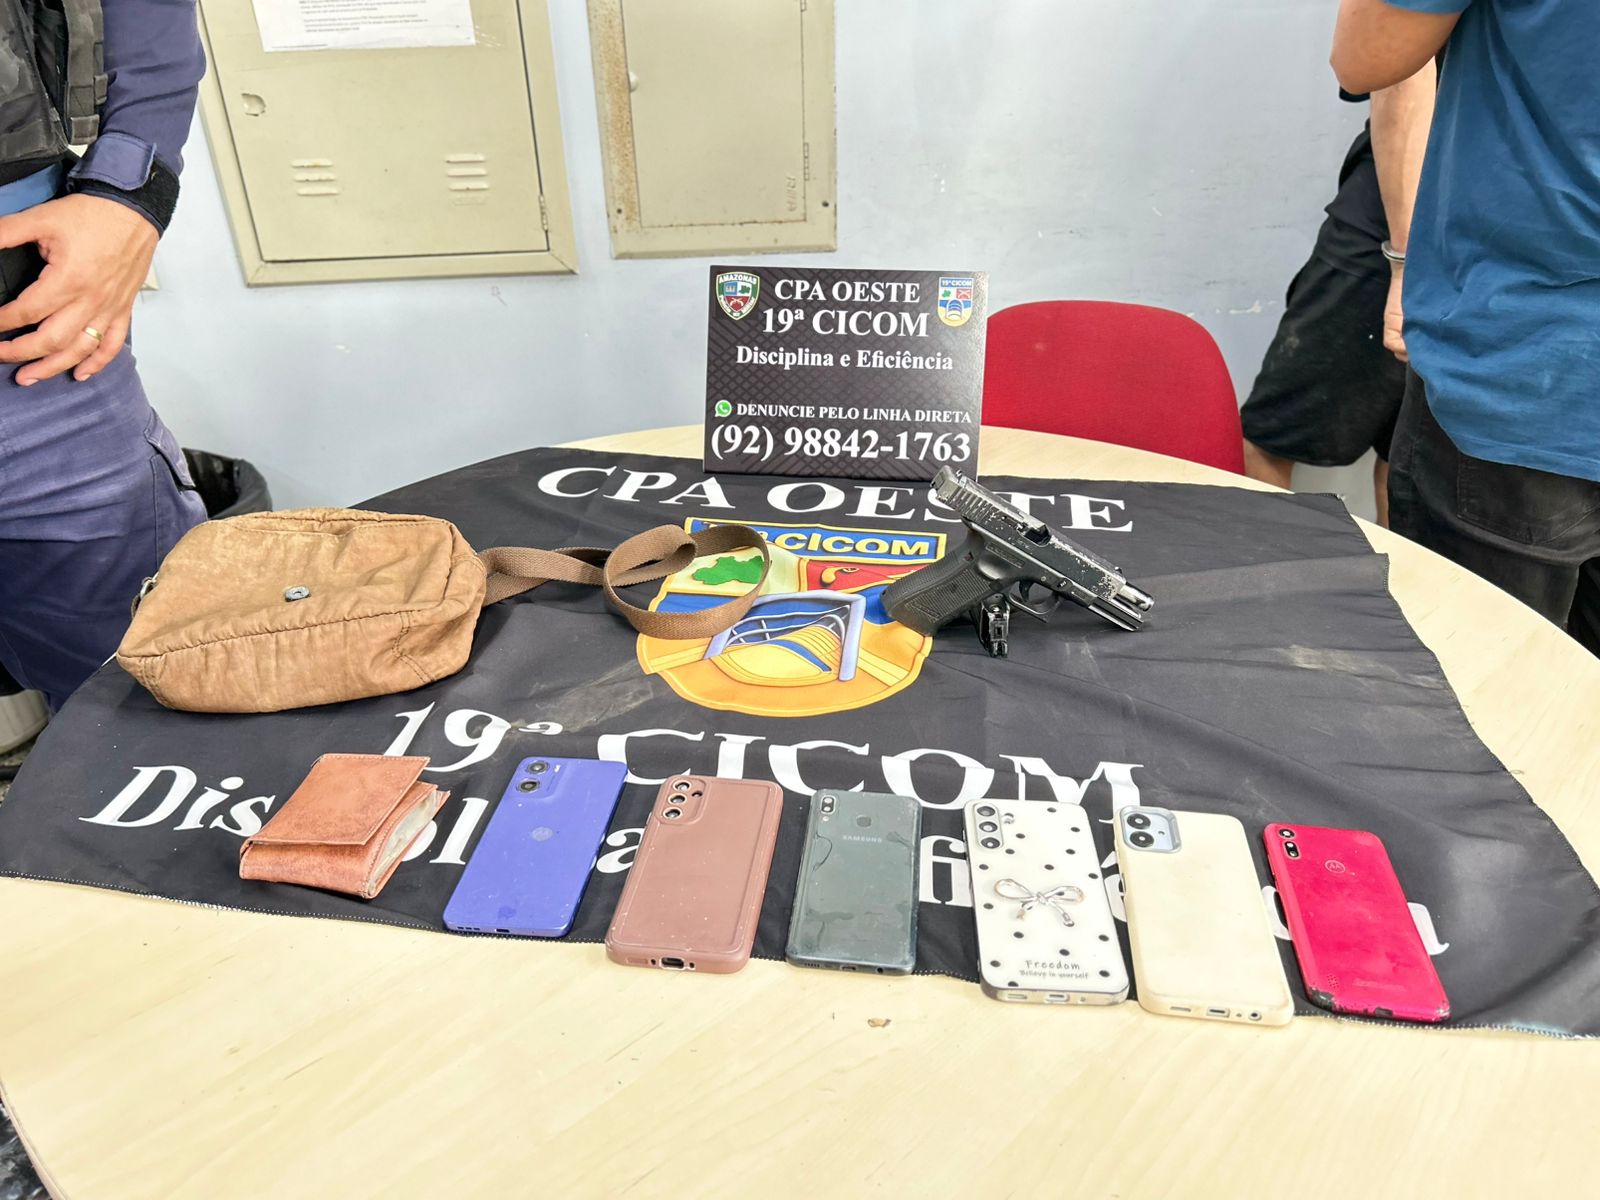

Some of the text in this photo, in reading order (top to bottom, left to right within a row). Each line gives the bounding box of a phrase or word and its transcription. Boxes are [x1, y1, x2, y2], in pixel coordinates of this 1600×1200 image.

[719, 275, 757, 284] AMAZONAS
[774, 279, 920, 304] CPA OESTE
[762, 308, 929, 338] 19ª CICOM
[736, 346, 953, 370] Disciplina e Eficiência
[737, 403, 971, 424] DENUNCIE PELO LINHA DIRETA
[711, 424, 971, 462] (92) 98842-1763
[537, 465, 736, 508] CPA
[774, 532, 930, 556] CICOM
[597, 728, 1144, 824] CICOM
[843, 835, 882, 843] SAMSUNG
[1026, 960, 1080, 970] Freedom
